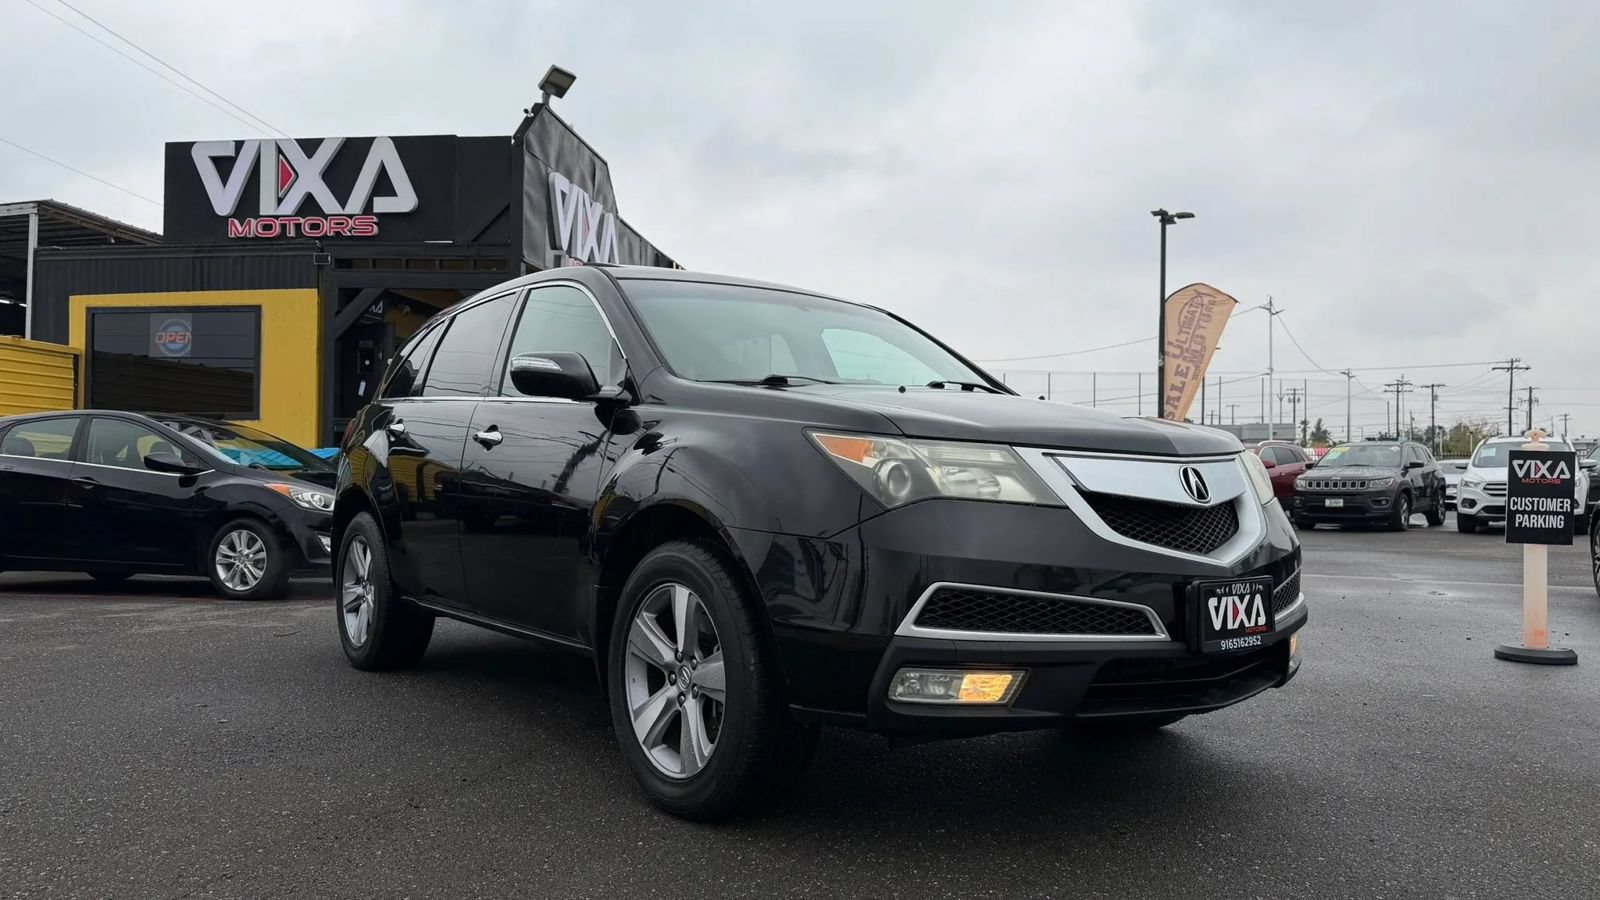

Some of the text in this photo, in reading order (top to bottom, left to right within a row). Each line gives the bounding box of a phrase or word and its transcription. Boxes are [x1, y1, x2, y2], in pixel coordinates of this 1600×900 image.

[190, 136, 419, 217] VIXA
[227, 215, 379, 239] MOTORS
[155, 332, 192, 345] OPEN
[1512, 459, 1571, 479] VIXA
[1510, 497, 1571, 512] CUSTOMER
[1515, 514, 1564, 529] PARKING
[1208, 594, 1267, 631] VIXA
[1221, 636, 1262, 650] 9165162952
